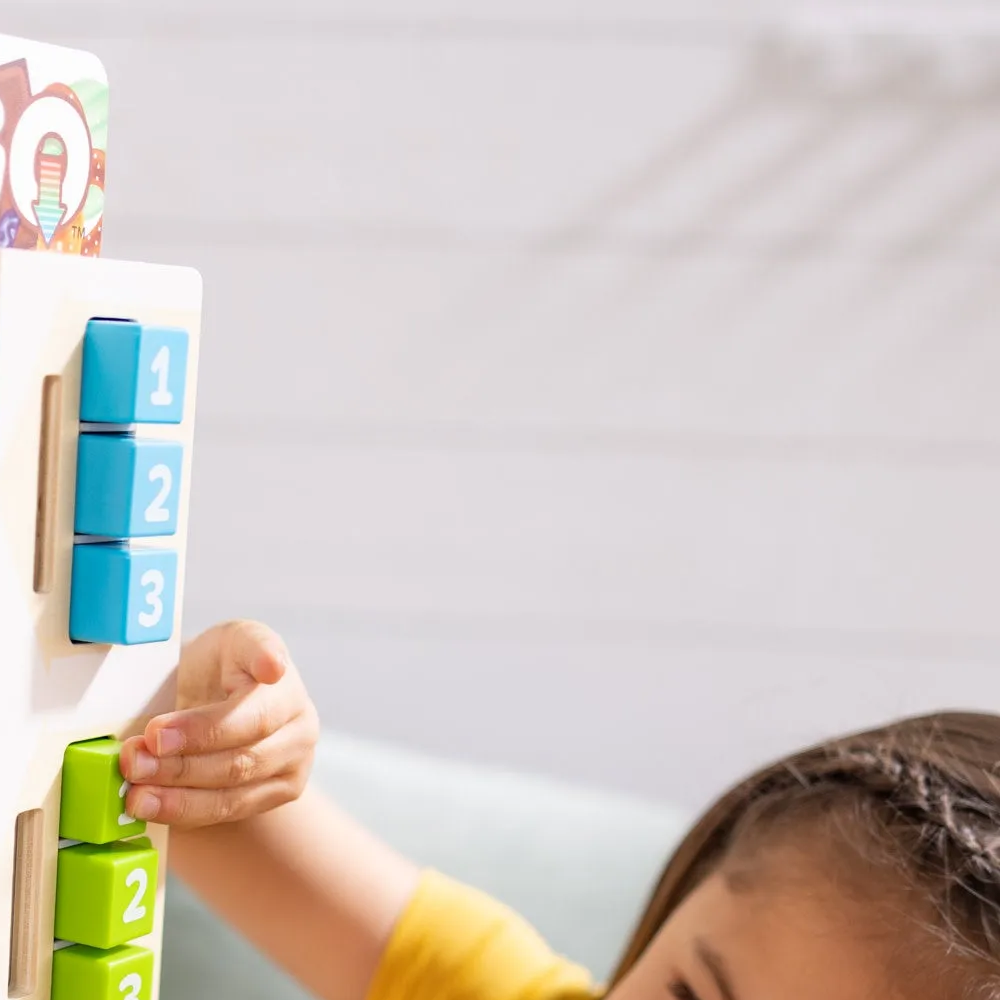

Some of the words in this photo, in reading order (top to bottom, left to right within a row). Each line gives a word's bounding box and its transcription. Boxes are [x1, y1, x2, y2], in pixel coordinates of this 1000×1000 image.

[150, 345, 174, 406] 1
[143, 463, 173, 523] 2
[137, 568, 165, 628] 3
[122, 867, 148, 924] 2
